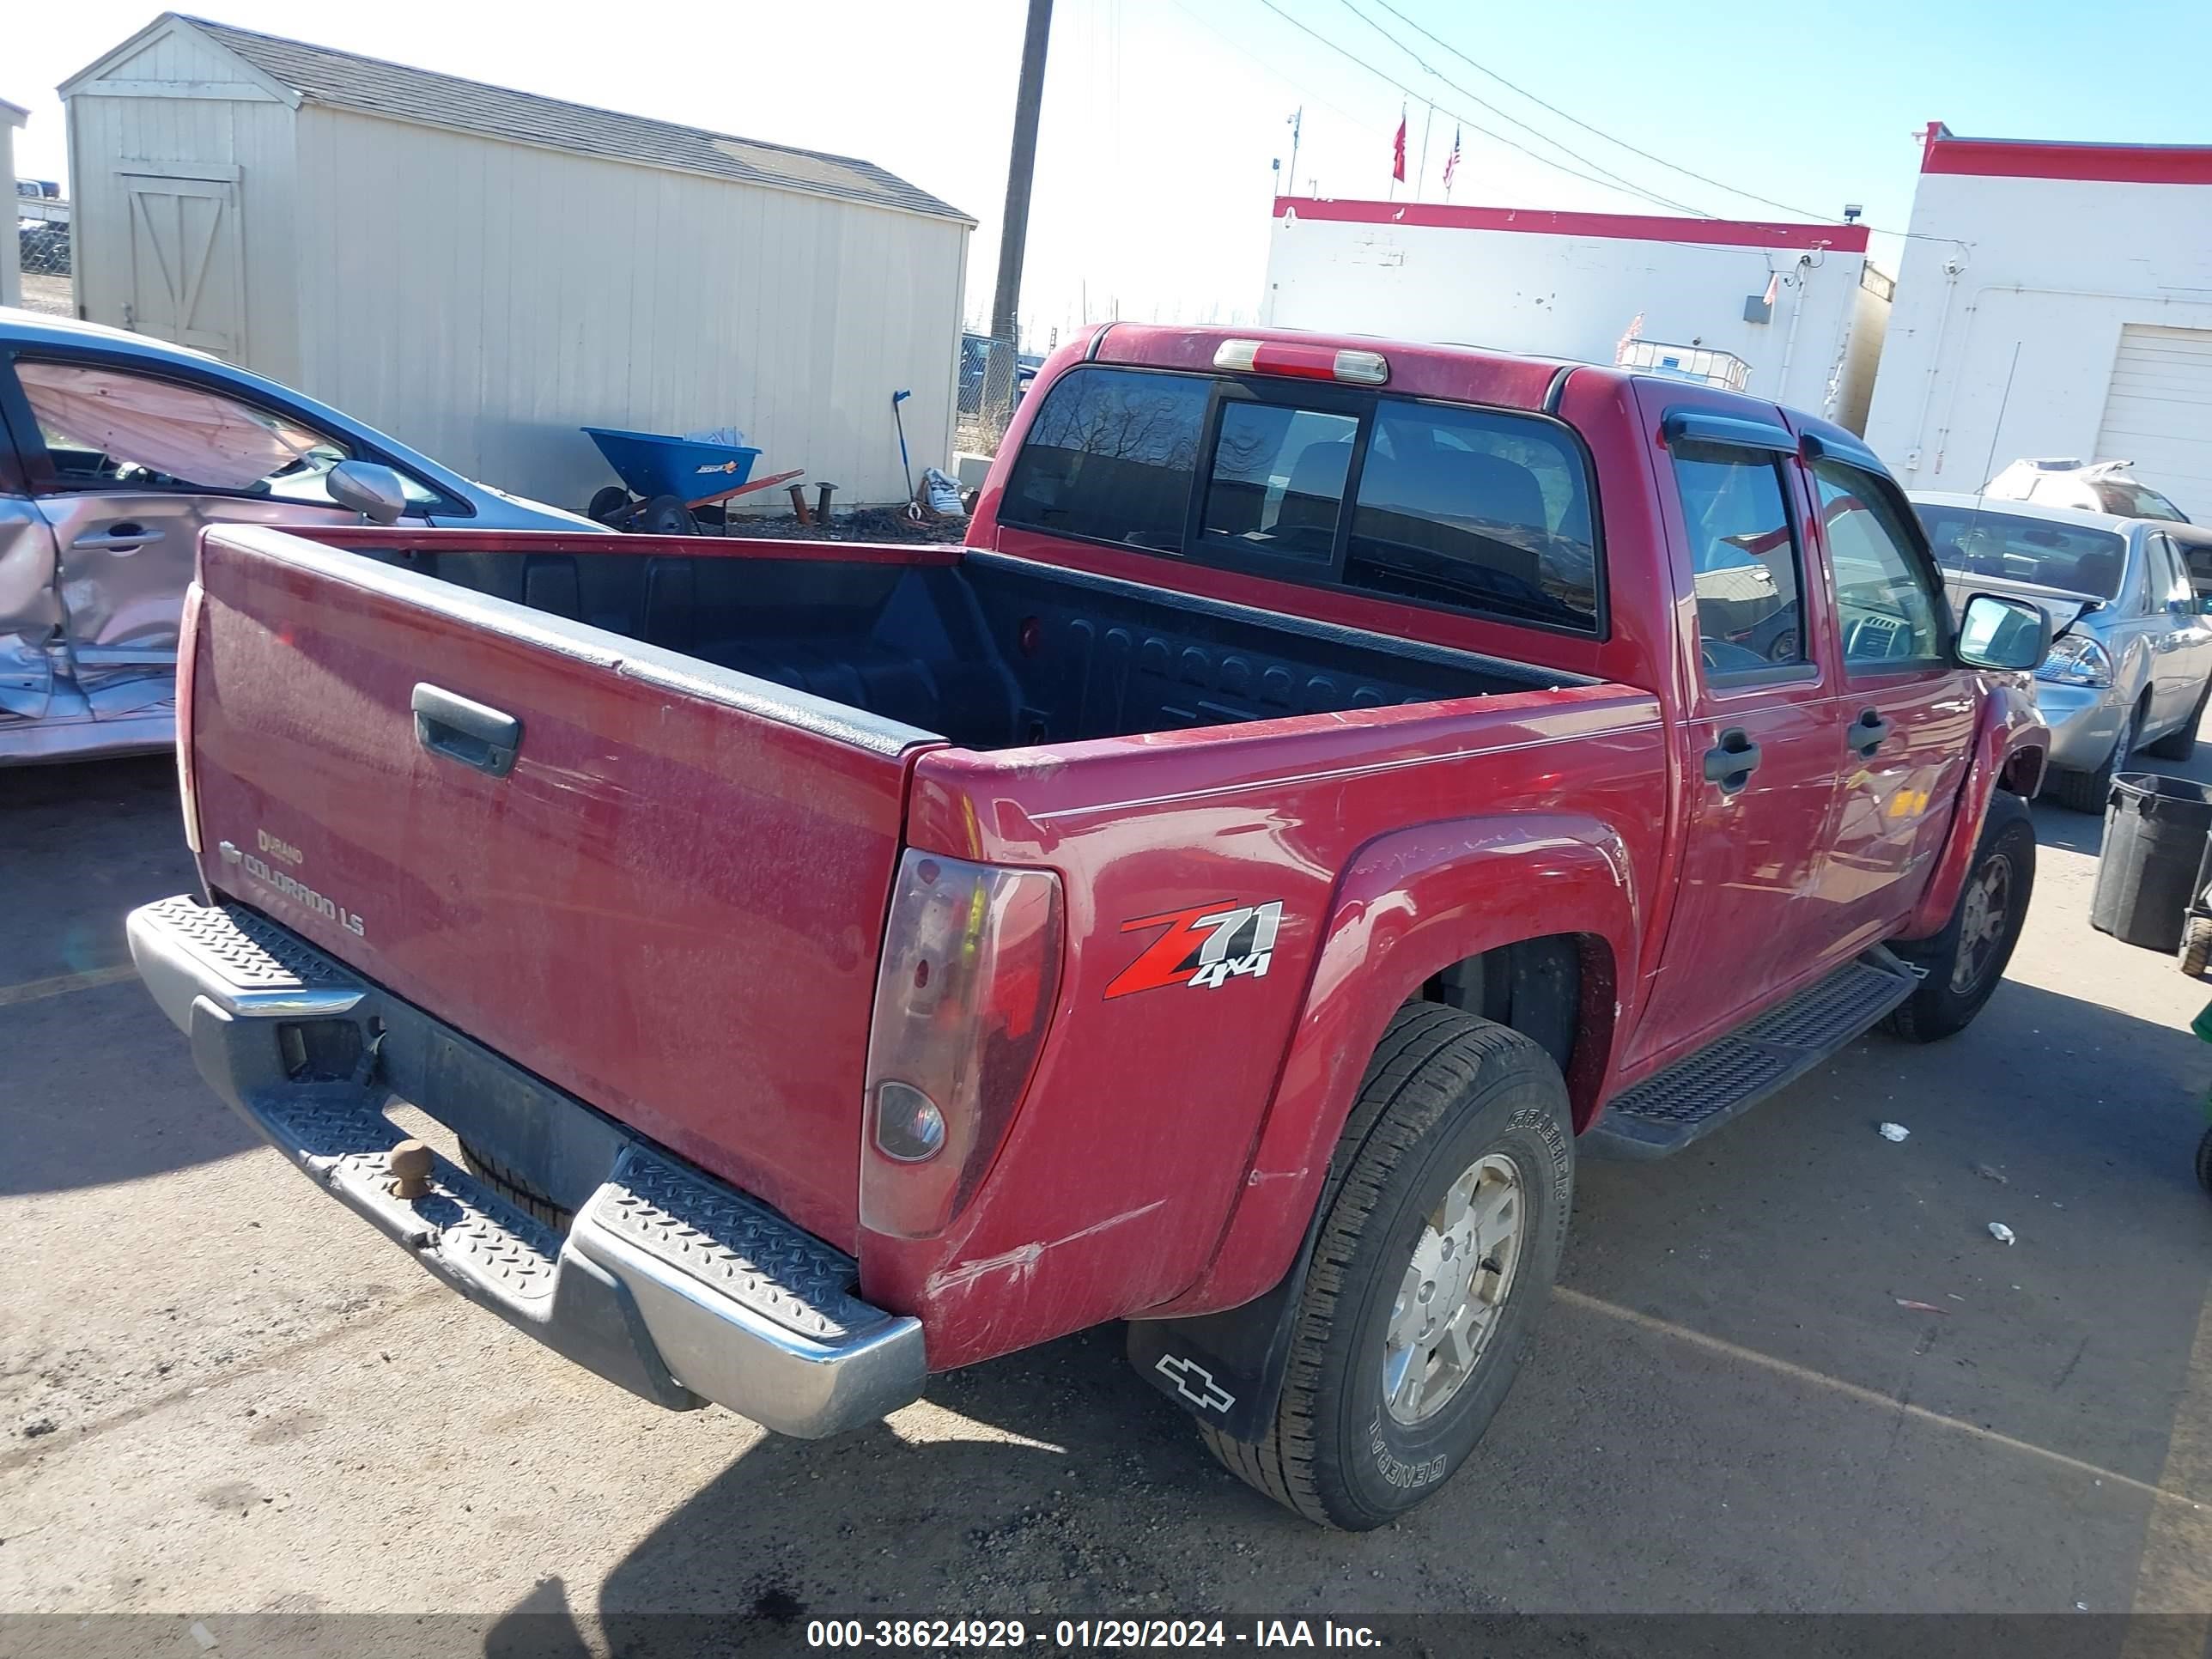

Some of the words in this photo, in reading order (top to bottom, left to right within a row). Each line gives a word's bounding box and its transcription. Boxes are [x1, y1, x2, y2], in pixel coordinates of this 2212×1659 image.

[244, 854, 337, 921] COLORADO
[340, 907, 365, 936] LS
[1103, 898, 1284, 1000] Z71
[1187, 951, 1273, 989] 4x4
[1504, 1108, 1569, 1200] GRABBER
[1368, 1404, 1448, 1489] GENERAL
